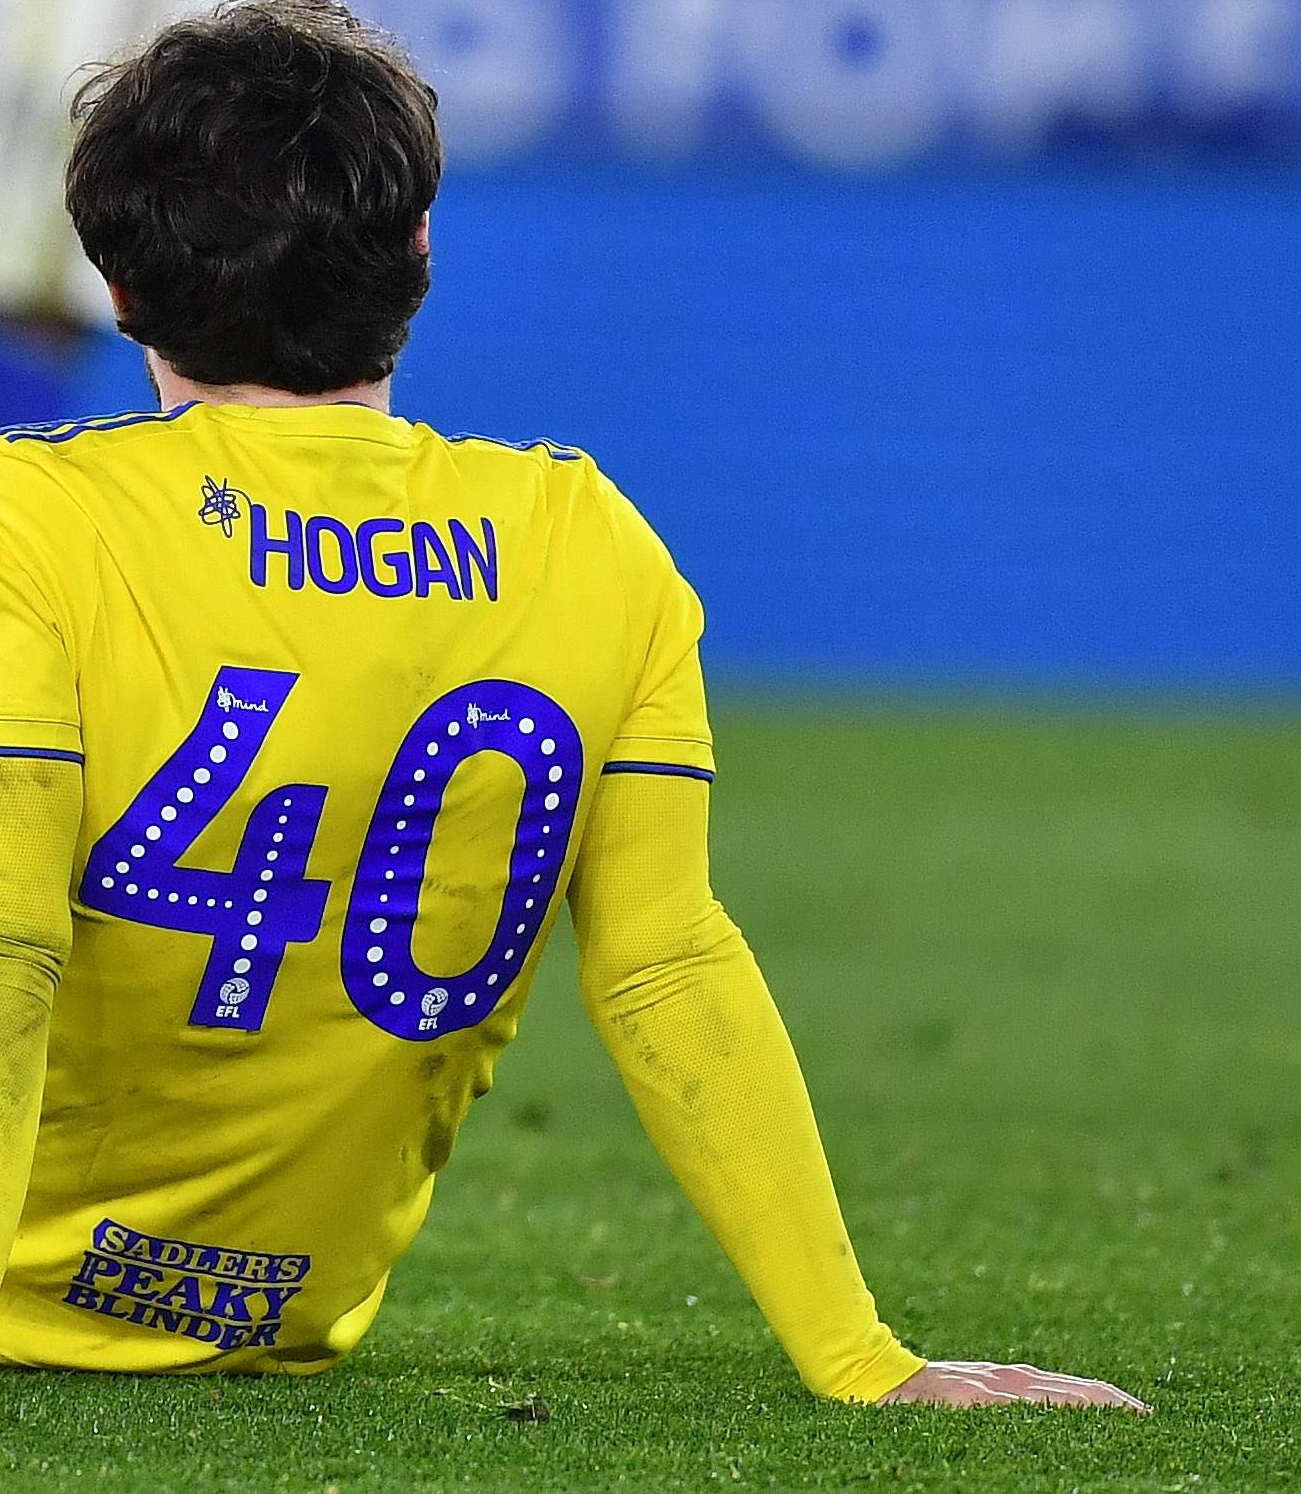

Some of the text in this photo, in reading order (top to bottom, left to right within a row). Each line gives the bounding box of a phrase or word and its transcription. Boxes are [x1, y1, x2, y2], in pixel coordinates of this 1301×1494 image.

[249, 504, 498, 602] HOGAN
[232, 699, 269, 713] mind
[479, 708, 512, 722] mind
[79, 665, 585, 1042] 40
[215, 1005, 241, 1019] EFL
[418, 1017, 438, 1031] EFL
[99, 1225, 304, 1282] SADLER'S
[72, 1250, 302, 1323] PEAKY
[61, 1283, 282, 1350] BLINDER
